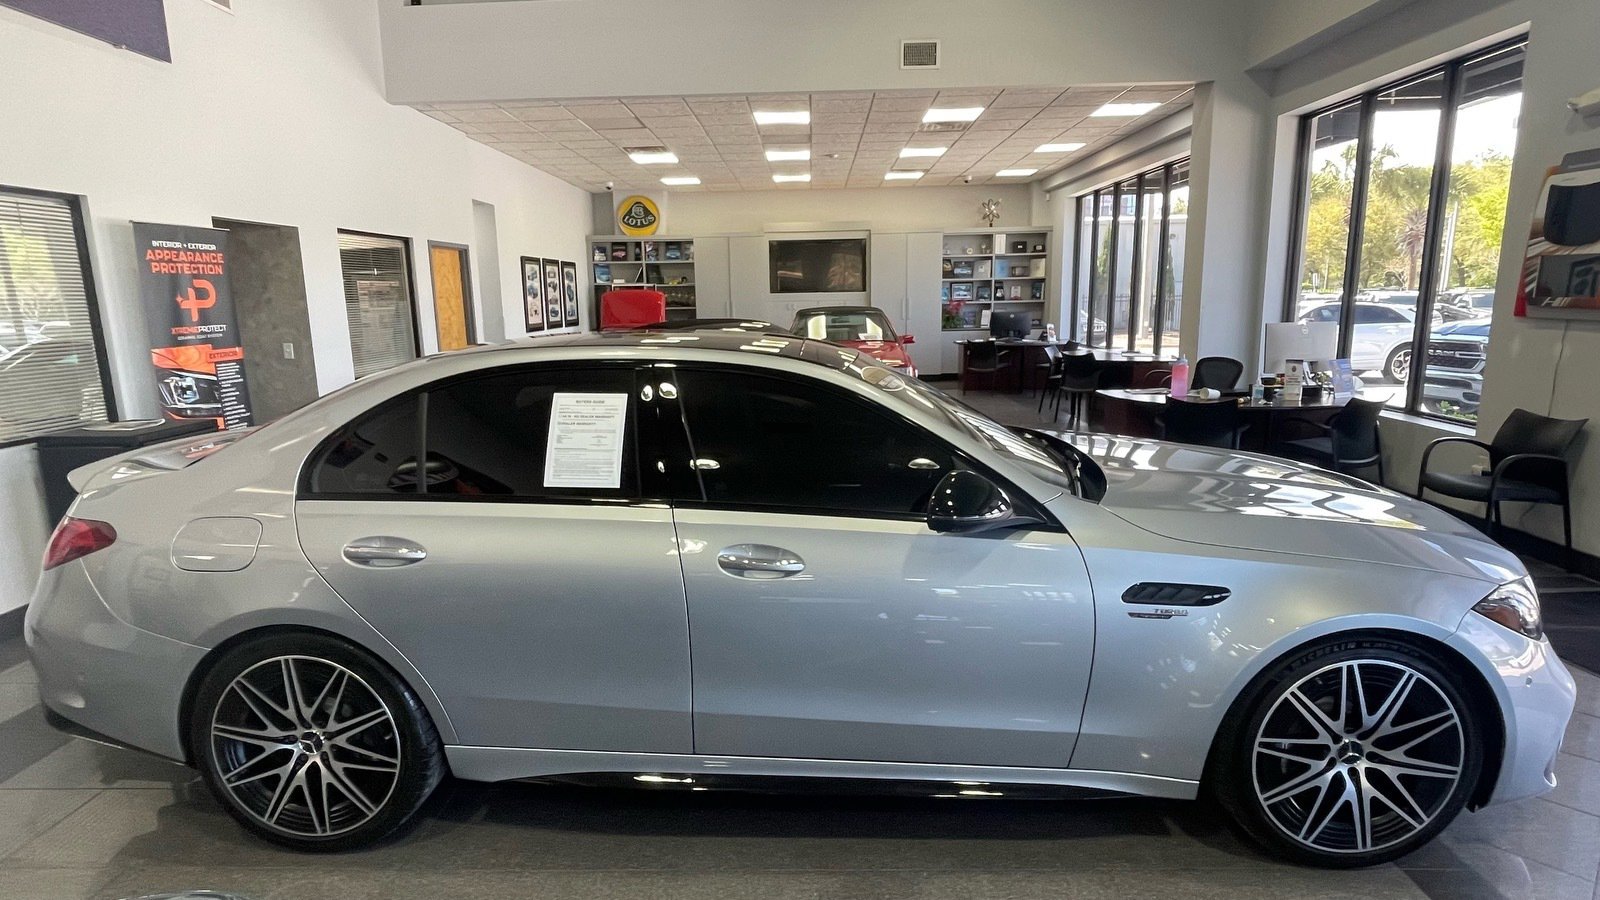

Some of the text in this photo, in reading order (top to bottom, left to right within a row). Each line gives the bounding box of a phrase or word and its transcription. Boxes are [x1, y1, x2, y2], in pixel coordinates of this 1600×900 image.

[624, 214, 655, 226] LOTUS
[151, 240, 182, 249] INTERIOR
[187, 242, 217, 251] EXTERIOR
[146, 249, 224, 263] APPEARANCE
[151, 262, 223, 275] PROTECTION
